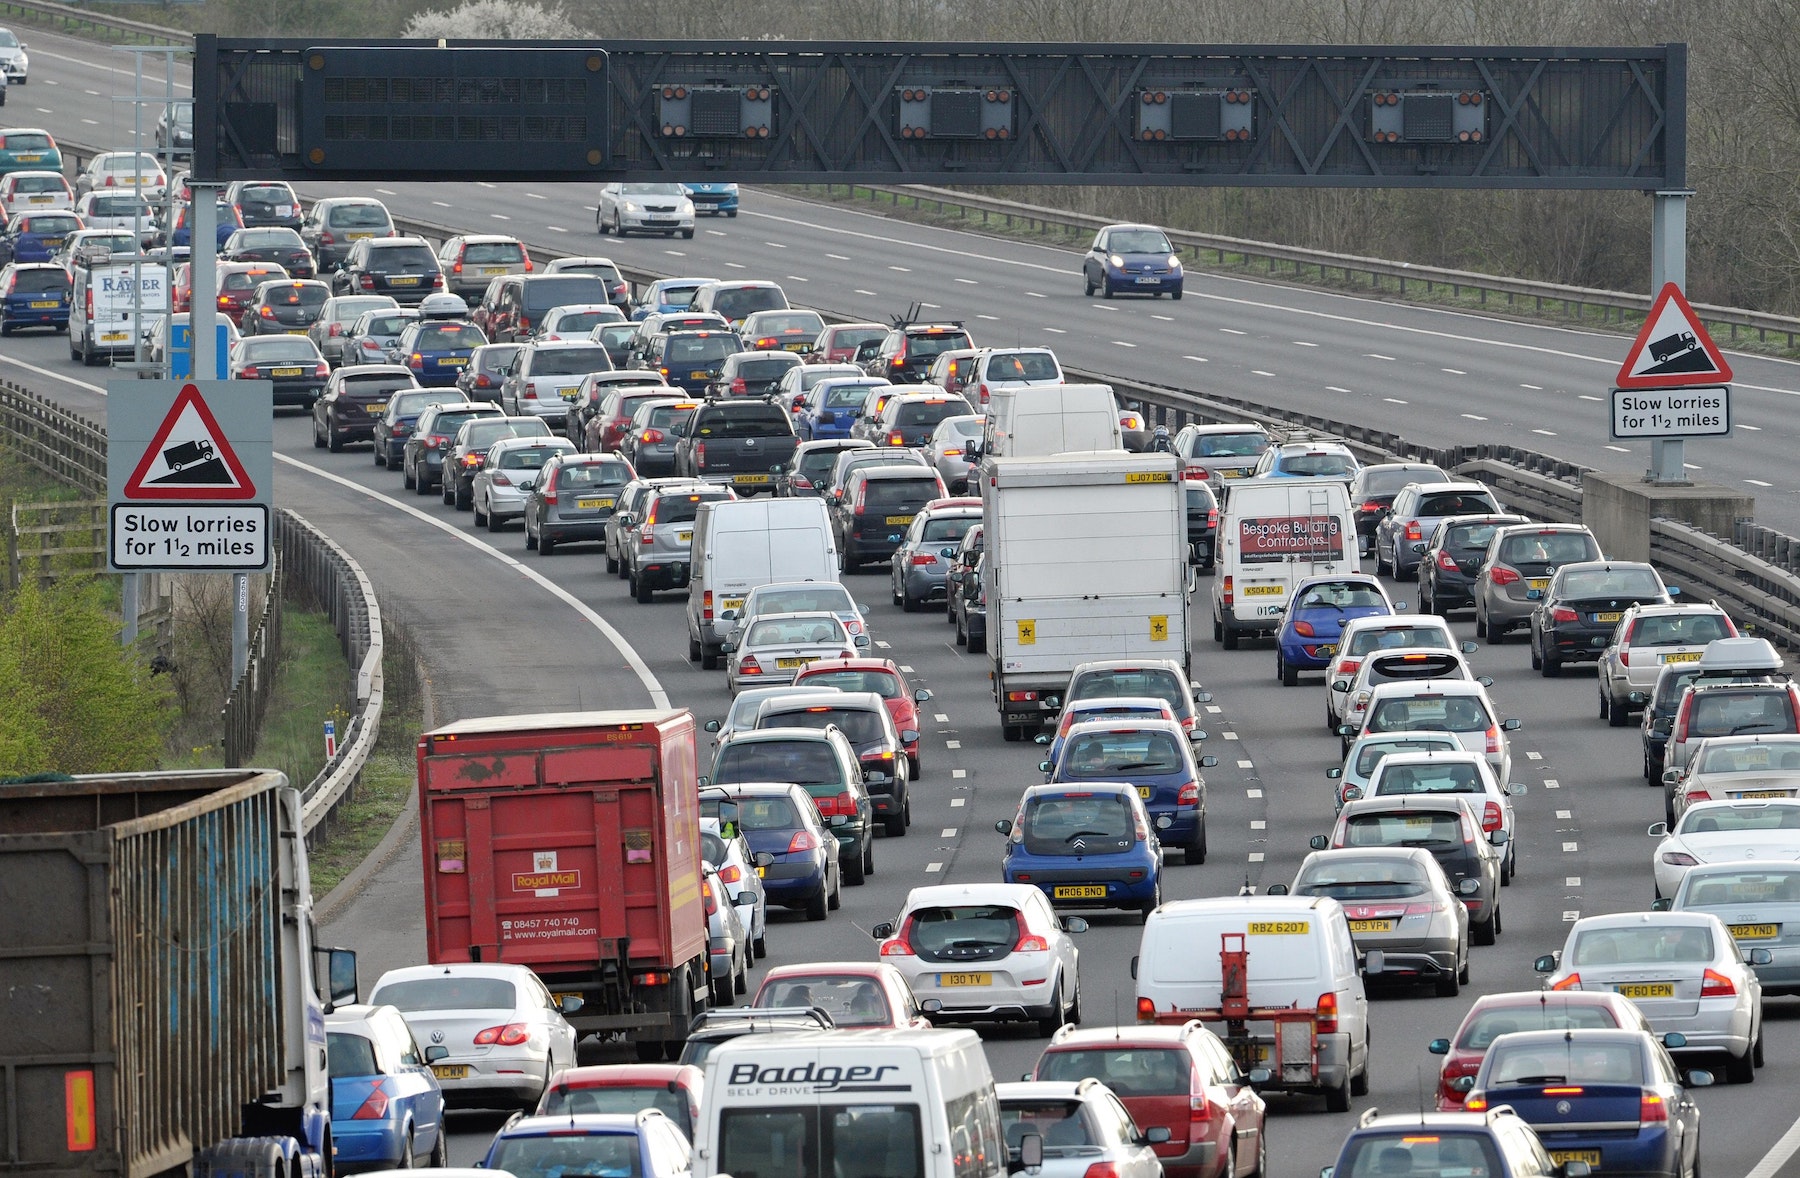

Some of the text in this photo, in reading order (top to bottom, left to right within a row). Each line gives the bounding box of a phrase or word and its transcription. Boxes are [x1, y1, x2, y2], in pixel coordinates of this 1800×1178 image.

[102, 278, 160, 291] RAYER
[1622, 396, 1720, 411] Slow lorries
[1622, 415, 1645, 429] for
[1677, 413, 1720, 428] miles
[1131, 473, 1150, 482] LJ07
[124, 514, 257, 533] Slow lorries
[1243, 522, 1290, 537] Bespoke
[125, 538, 156, 556] for
[197, 538, 254, 556] miles
[1257, 534, 1324, 548] Contractors
[1666, 655, 1686, 663] EY54
[517, 872, 576, 888] Royal Mail
[1058, 887, 1082, 897] WR06
[514, 917, 579, 929] 08457 740 740
[1252, 922, 1304, 933] RBZ 6207
[1370, 920, 1388, 930] VPW
[514, 927, 597, 940] www.royalmail.com
[969, 974, 981, 983] TV
[1620, 985, 1672, 997] WF60 EPN
[728, 1062, 900, 1089] Badger
[727, 1086, 812, 1097] SELF DRIVE
